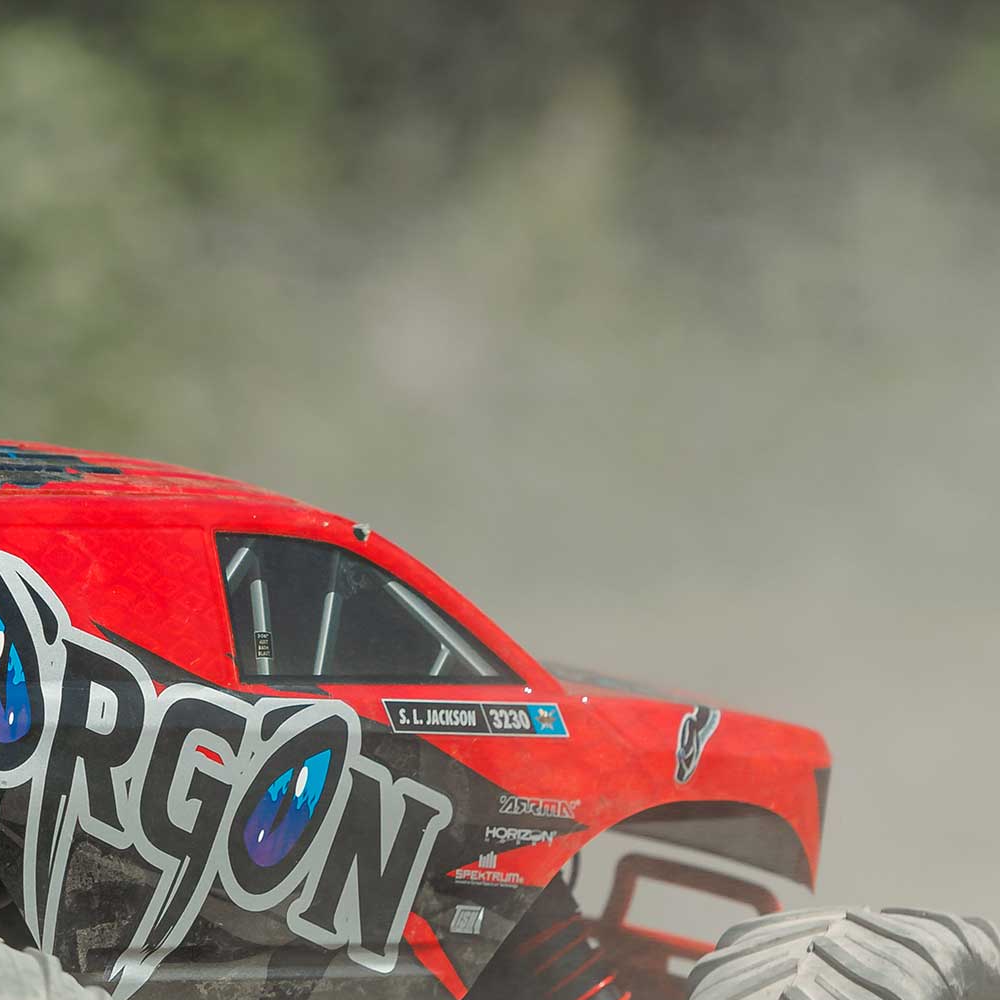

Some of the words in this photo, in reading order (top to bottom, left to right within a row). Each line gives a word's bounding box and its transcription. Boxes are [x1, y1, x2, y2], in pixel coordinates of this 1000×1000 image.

[399, 708, 410, 725] S.
[413, 709, 424, 726] L.
[426, 709, 477, 727] JACKSON
[489, 709, 531, 730] 3230
[485, 826, 557, 842] HORIZON
[455, 868, 520, 883] SPEKTRUM
